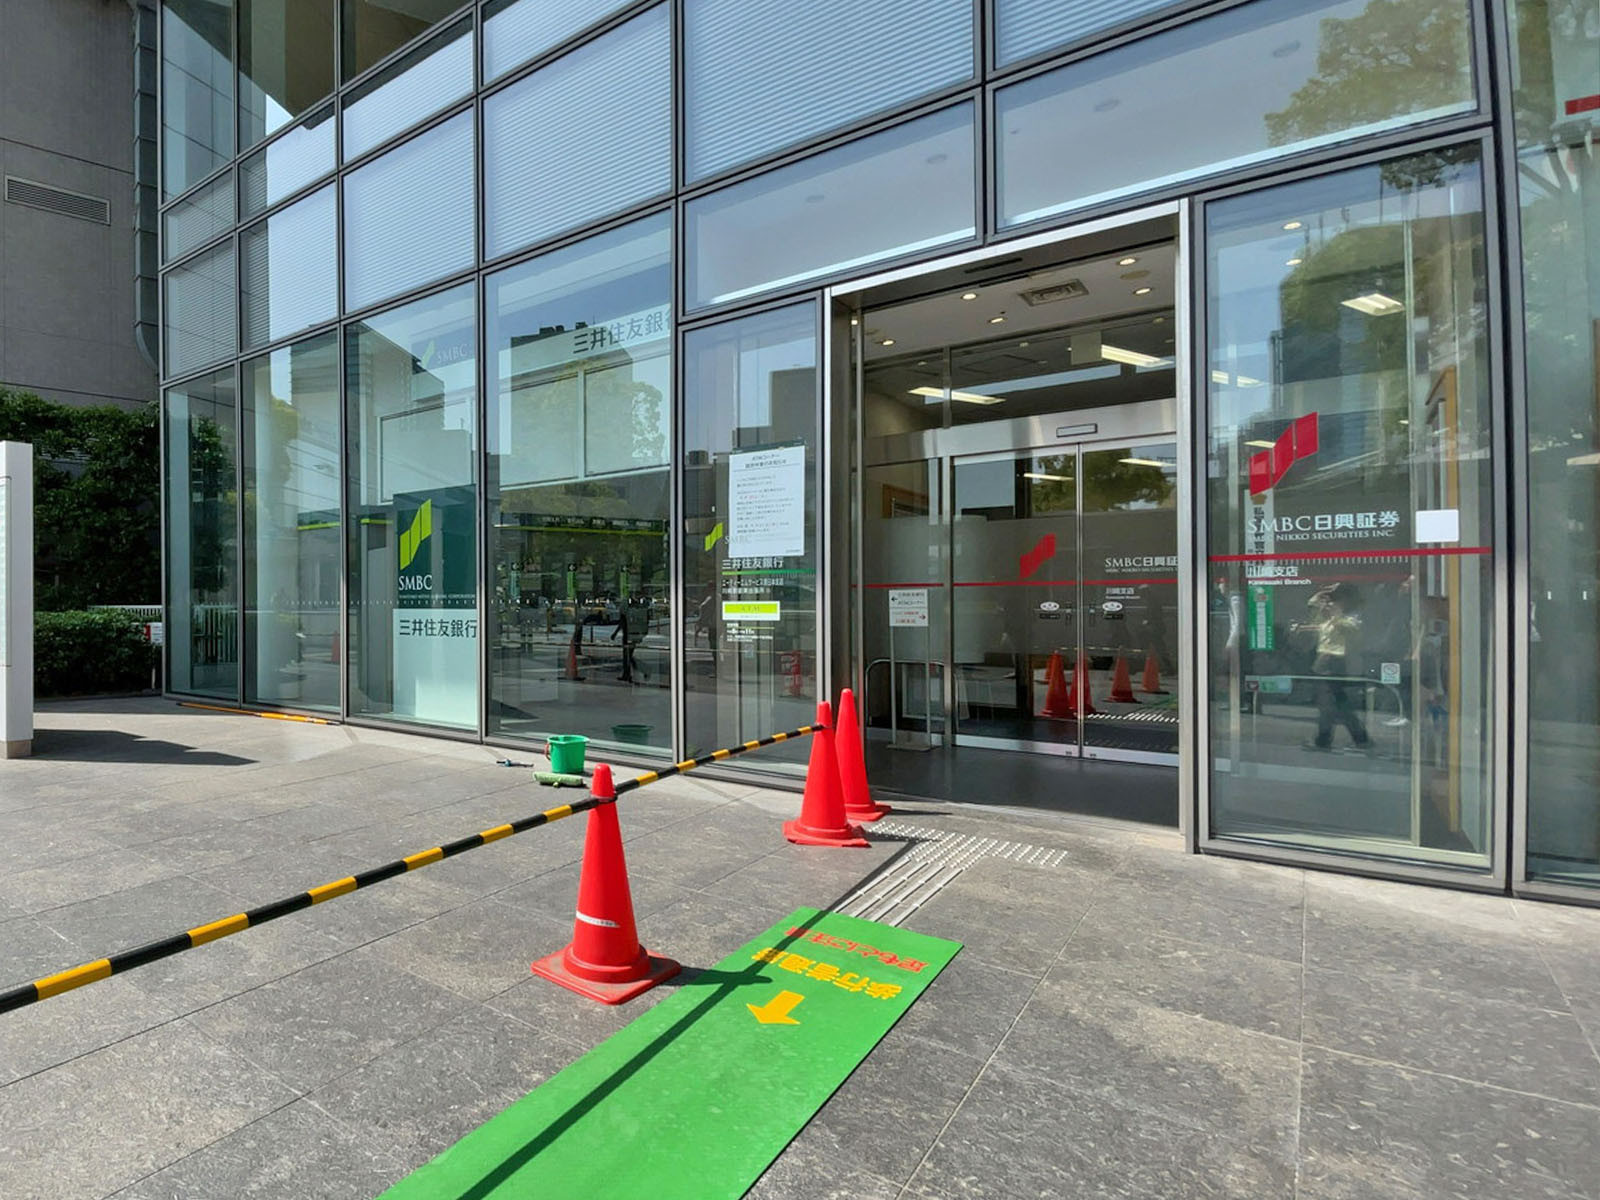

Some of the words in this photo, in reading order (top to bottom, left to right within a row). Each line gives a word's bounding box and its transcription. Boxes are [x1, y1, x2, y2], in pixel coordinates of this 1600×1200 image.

[1247, 510, 1400, 534] SMBC日興証券
[1276, 533, 1309, 541] NIKKO
[1312, 530, 1370, 540] SECURITIES
[721, 557, 784, 570] 三井住友銀行
[398, 575, 433, 591] SMBC
[399, 618, 477, 638] 三井住友銀行
